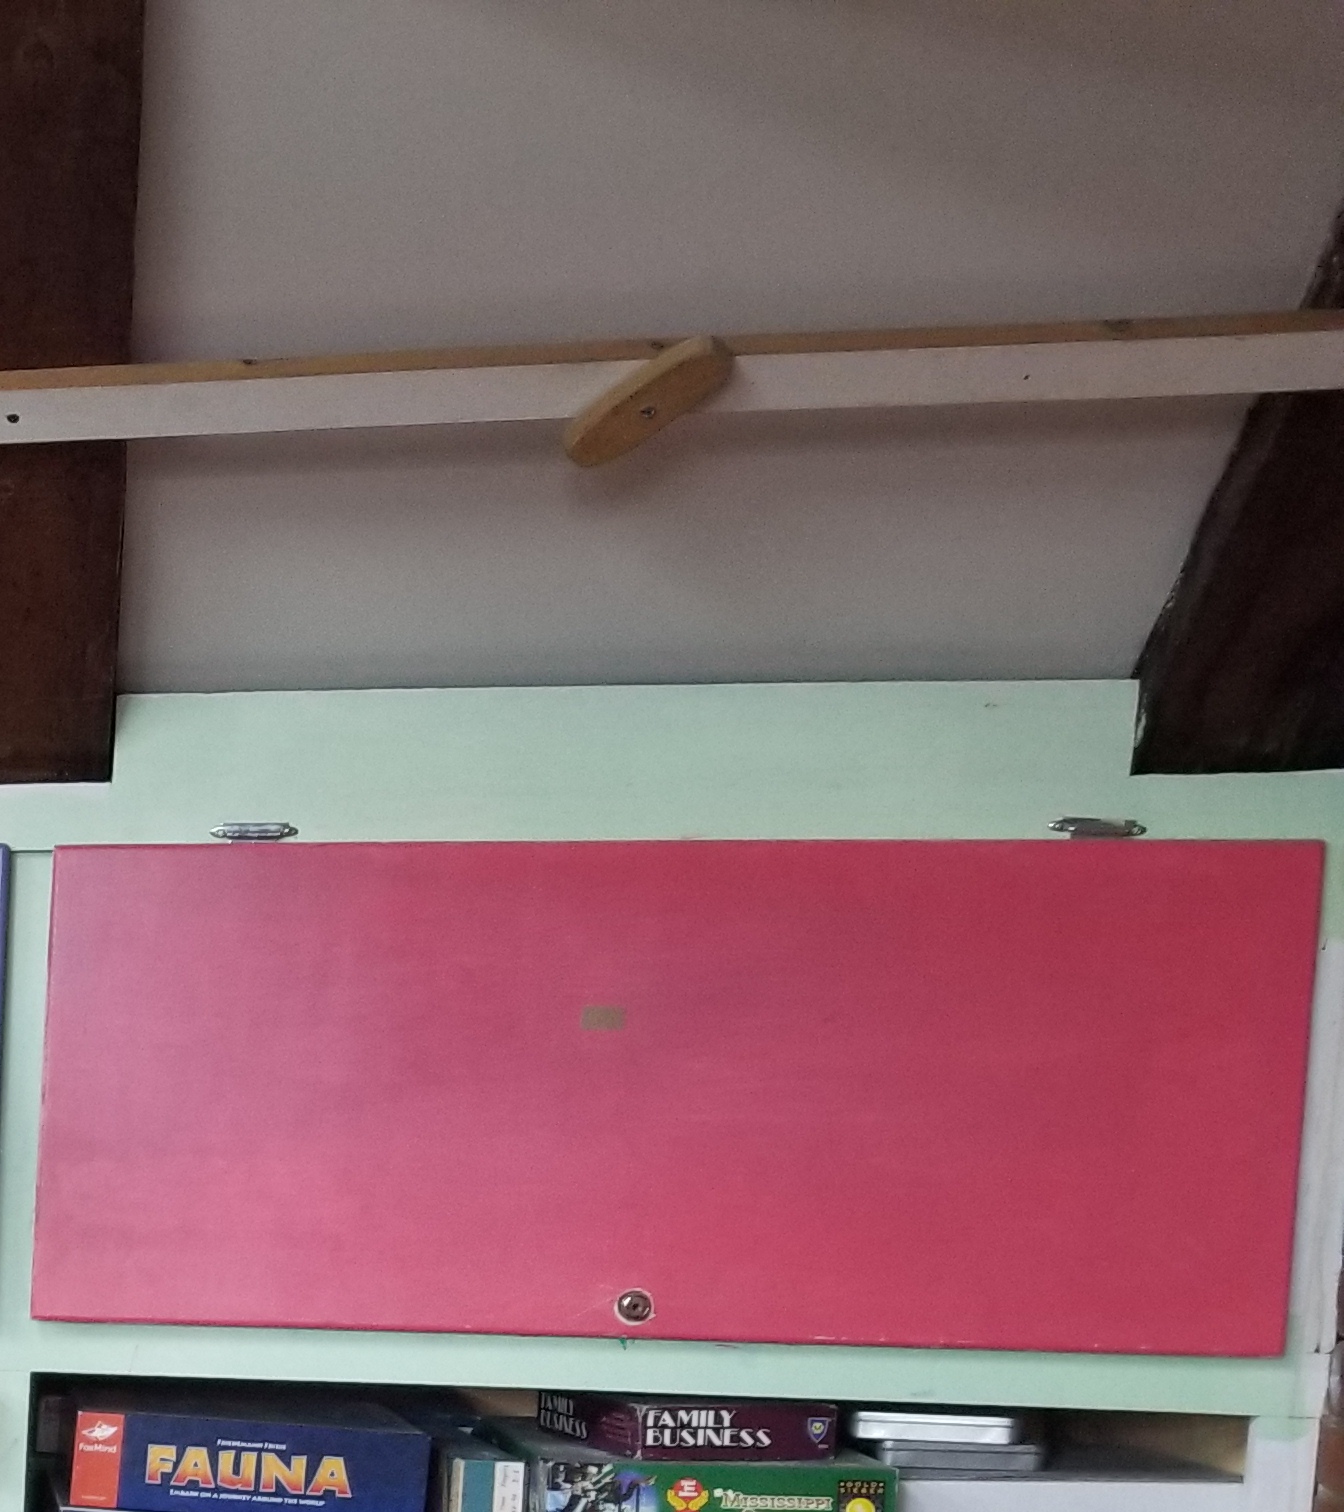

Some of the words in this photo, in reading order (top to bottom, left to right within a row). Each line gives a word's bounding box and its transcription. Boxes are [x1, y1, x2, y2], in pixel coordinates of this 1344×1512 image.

[646, 1409, 737, 1428] FAMILY
[78, 1442, 117, 1454] FoxMind
[645, 1427, 773, 1448] BUSINESS
[145, 1443, 353, 1499] FAUNA
[721, 1490, 834, 1511] MISSISSIPPI
